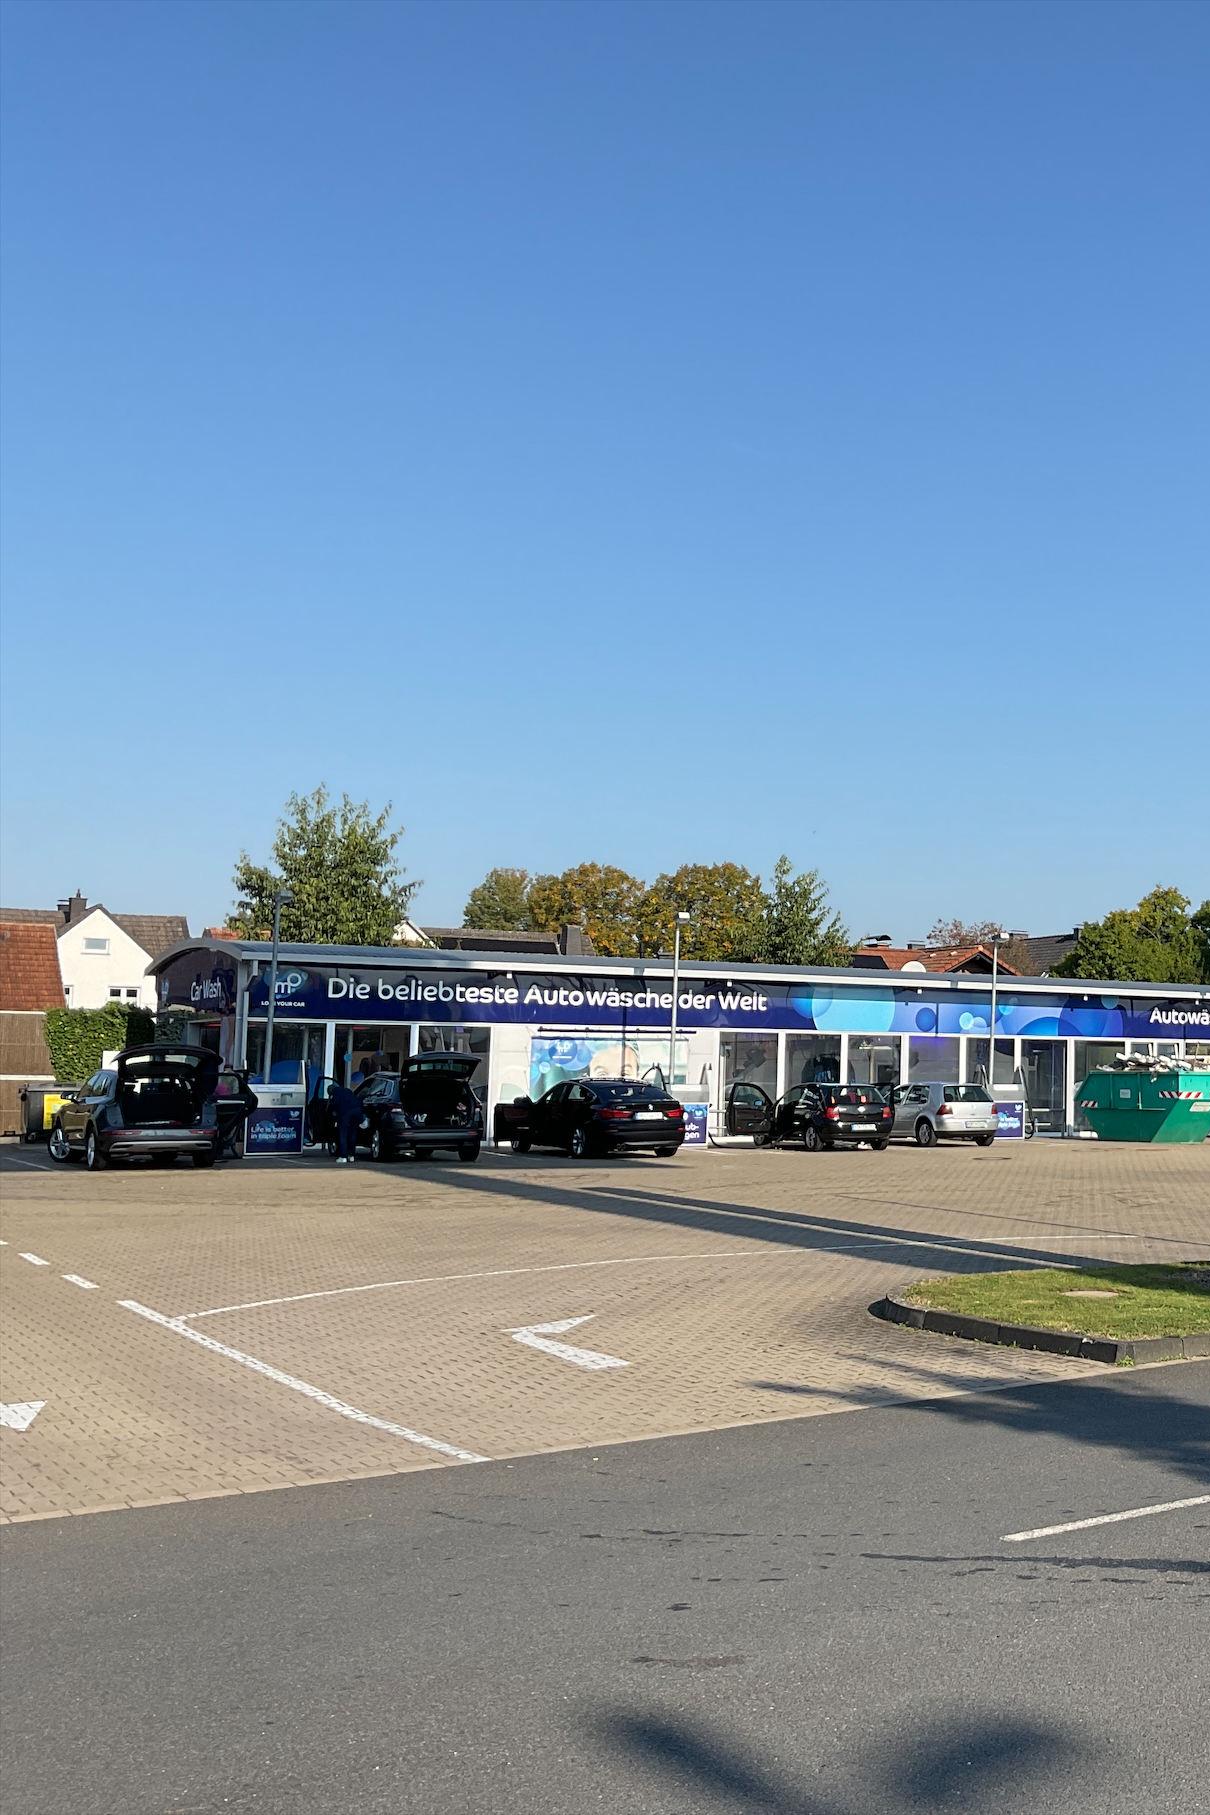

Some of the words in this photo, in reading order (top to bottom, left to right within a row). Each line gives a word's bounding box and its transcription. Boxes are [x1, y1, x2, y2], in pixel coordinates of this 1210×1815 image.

[190, 980, 203, 1001] Car
[203, 976, 222, 999] Wash
[327, 977, 371, 999] Die
[377, 978, 519, 1004] beliebteste
[678, 988, 716, 1010] der
[718, 990, 768, 1011] Welt
